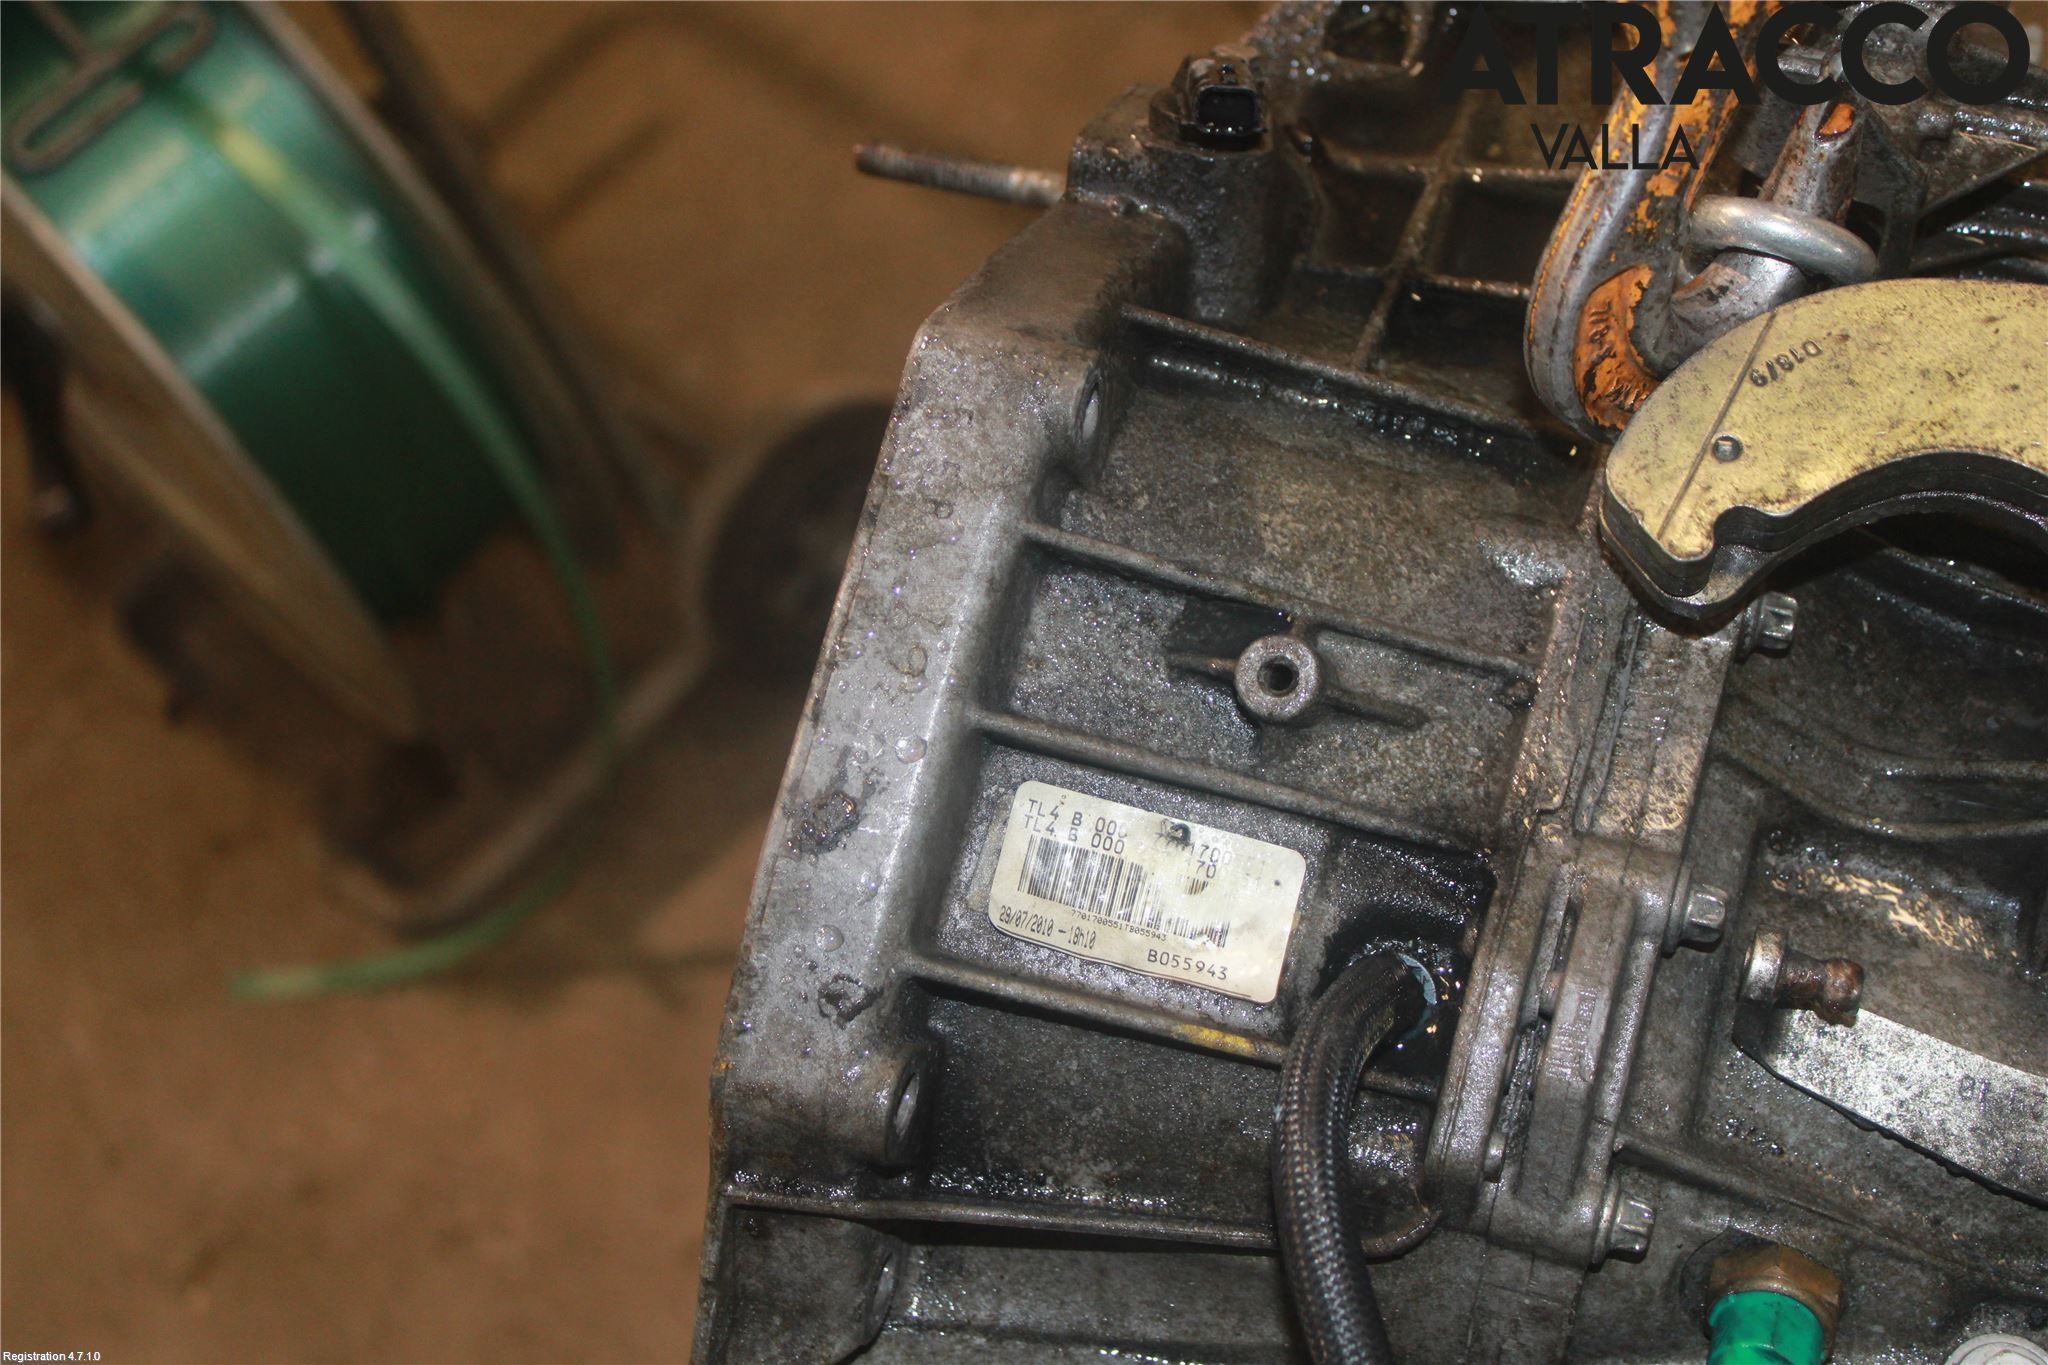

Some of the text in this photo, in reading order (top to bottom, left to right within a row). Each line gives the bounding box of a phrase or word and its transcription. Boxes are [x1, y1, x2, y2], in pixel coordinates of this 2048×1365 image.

[1028, 798, 1060, 821] TL4
[1071, 811, 1083, 827] B
[1090, 832, 1126, 855] 000
[999, 904, 1054, 938] 29/07/2010
[1146, 948, 1229, 981] B055943
